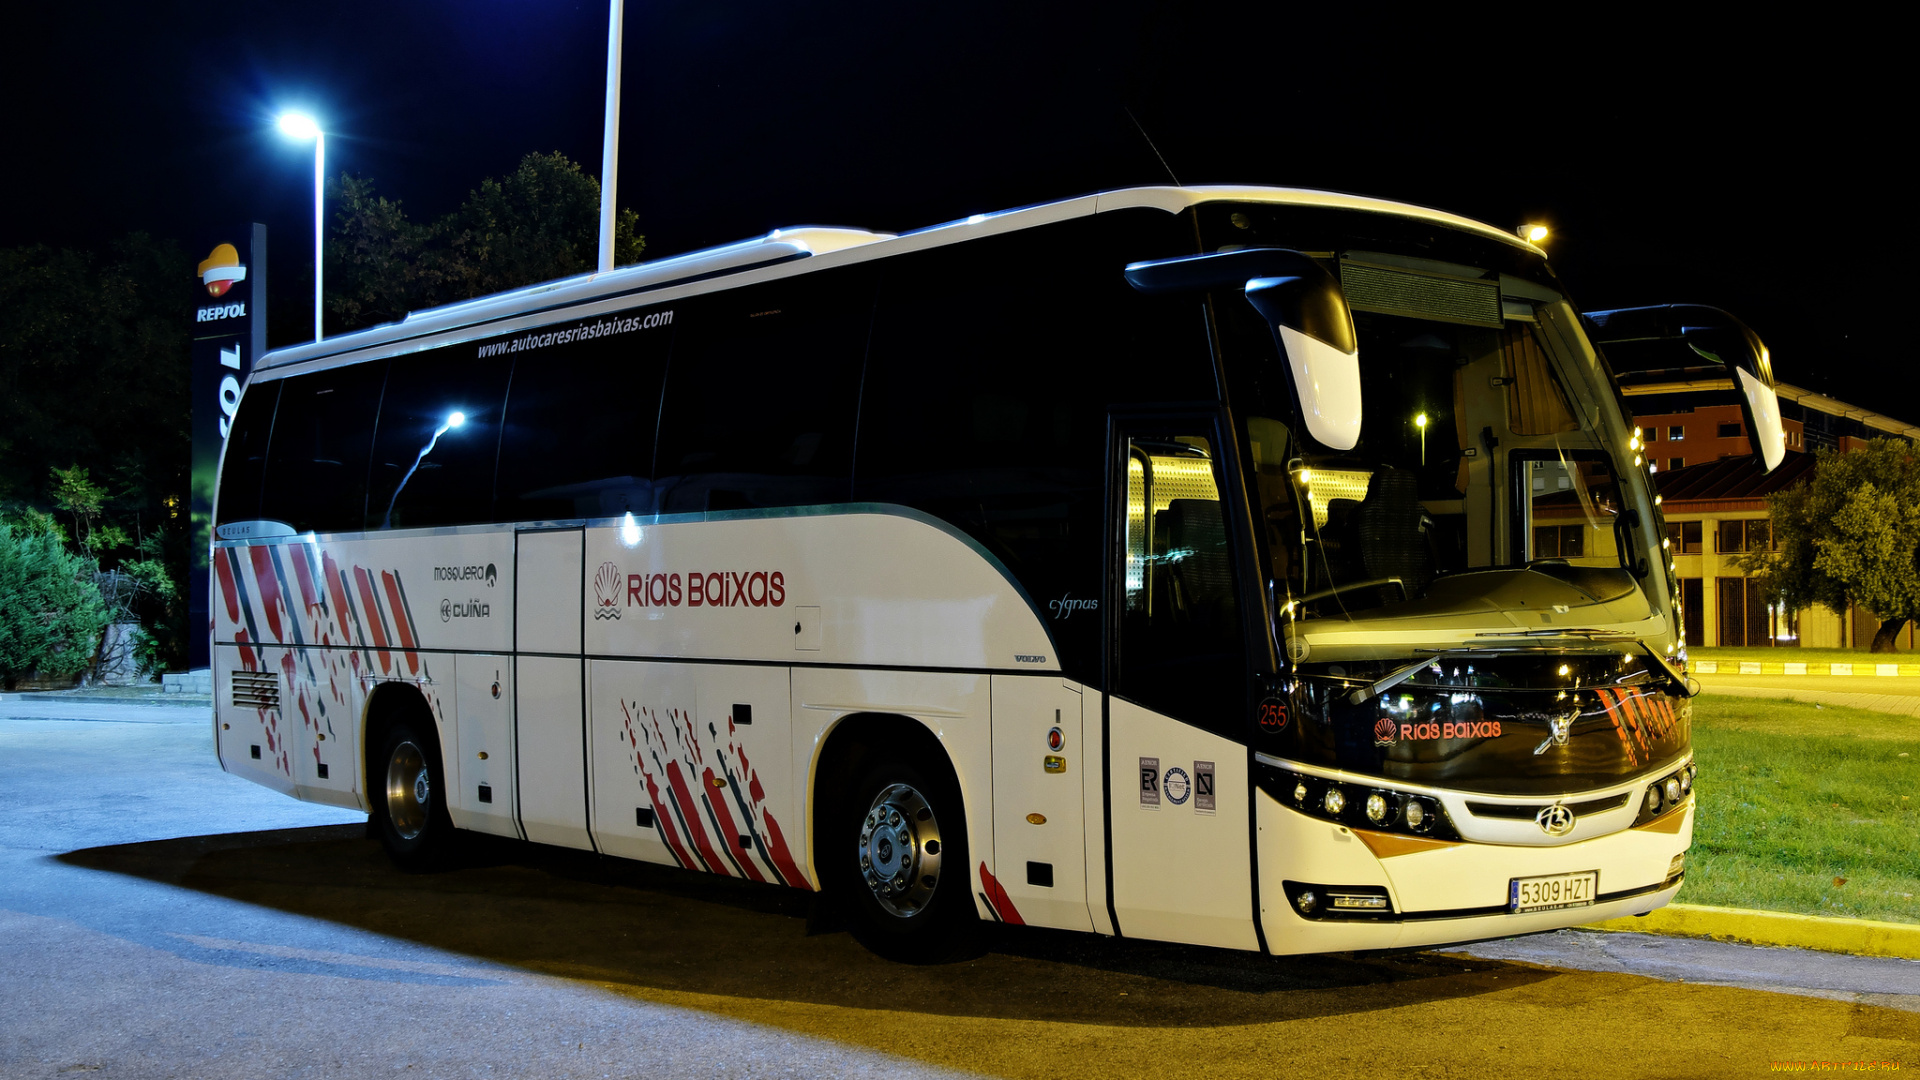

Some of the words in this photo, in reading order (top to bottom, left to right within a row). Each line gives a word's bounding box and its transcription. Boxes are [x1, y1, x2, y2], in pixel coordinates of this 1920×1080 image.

[197, 303, 247, 323] REPSOL
[478, 309, 674, 359] www.autocaresriasbaixas.com
[222, 526, 251, 536] BEULAS
[1049, 592, 1098, 619] cygnus
[1014, 654, 1047, 664] VOLVO
[1260, 703, 1287, 726] 255
[1522, 880, 1560, 904] 5309
[1564, 878, 1591, 901] HZT
